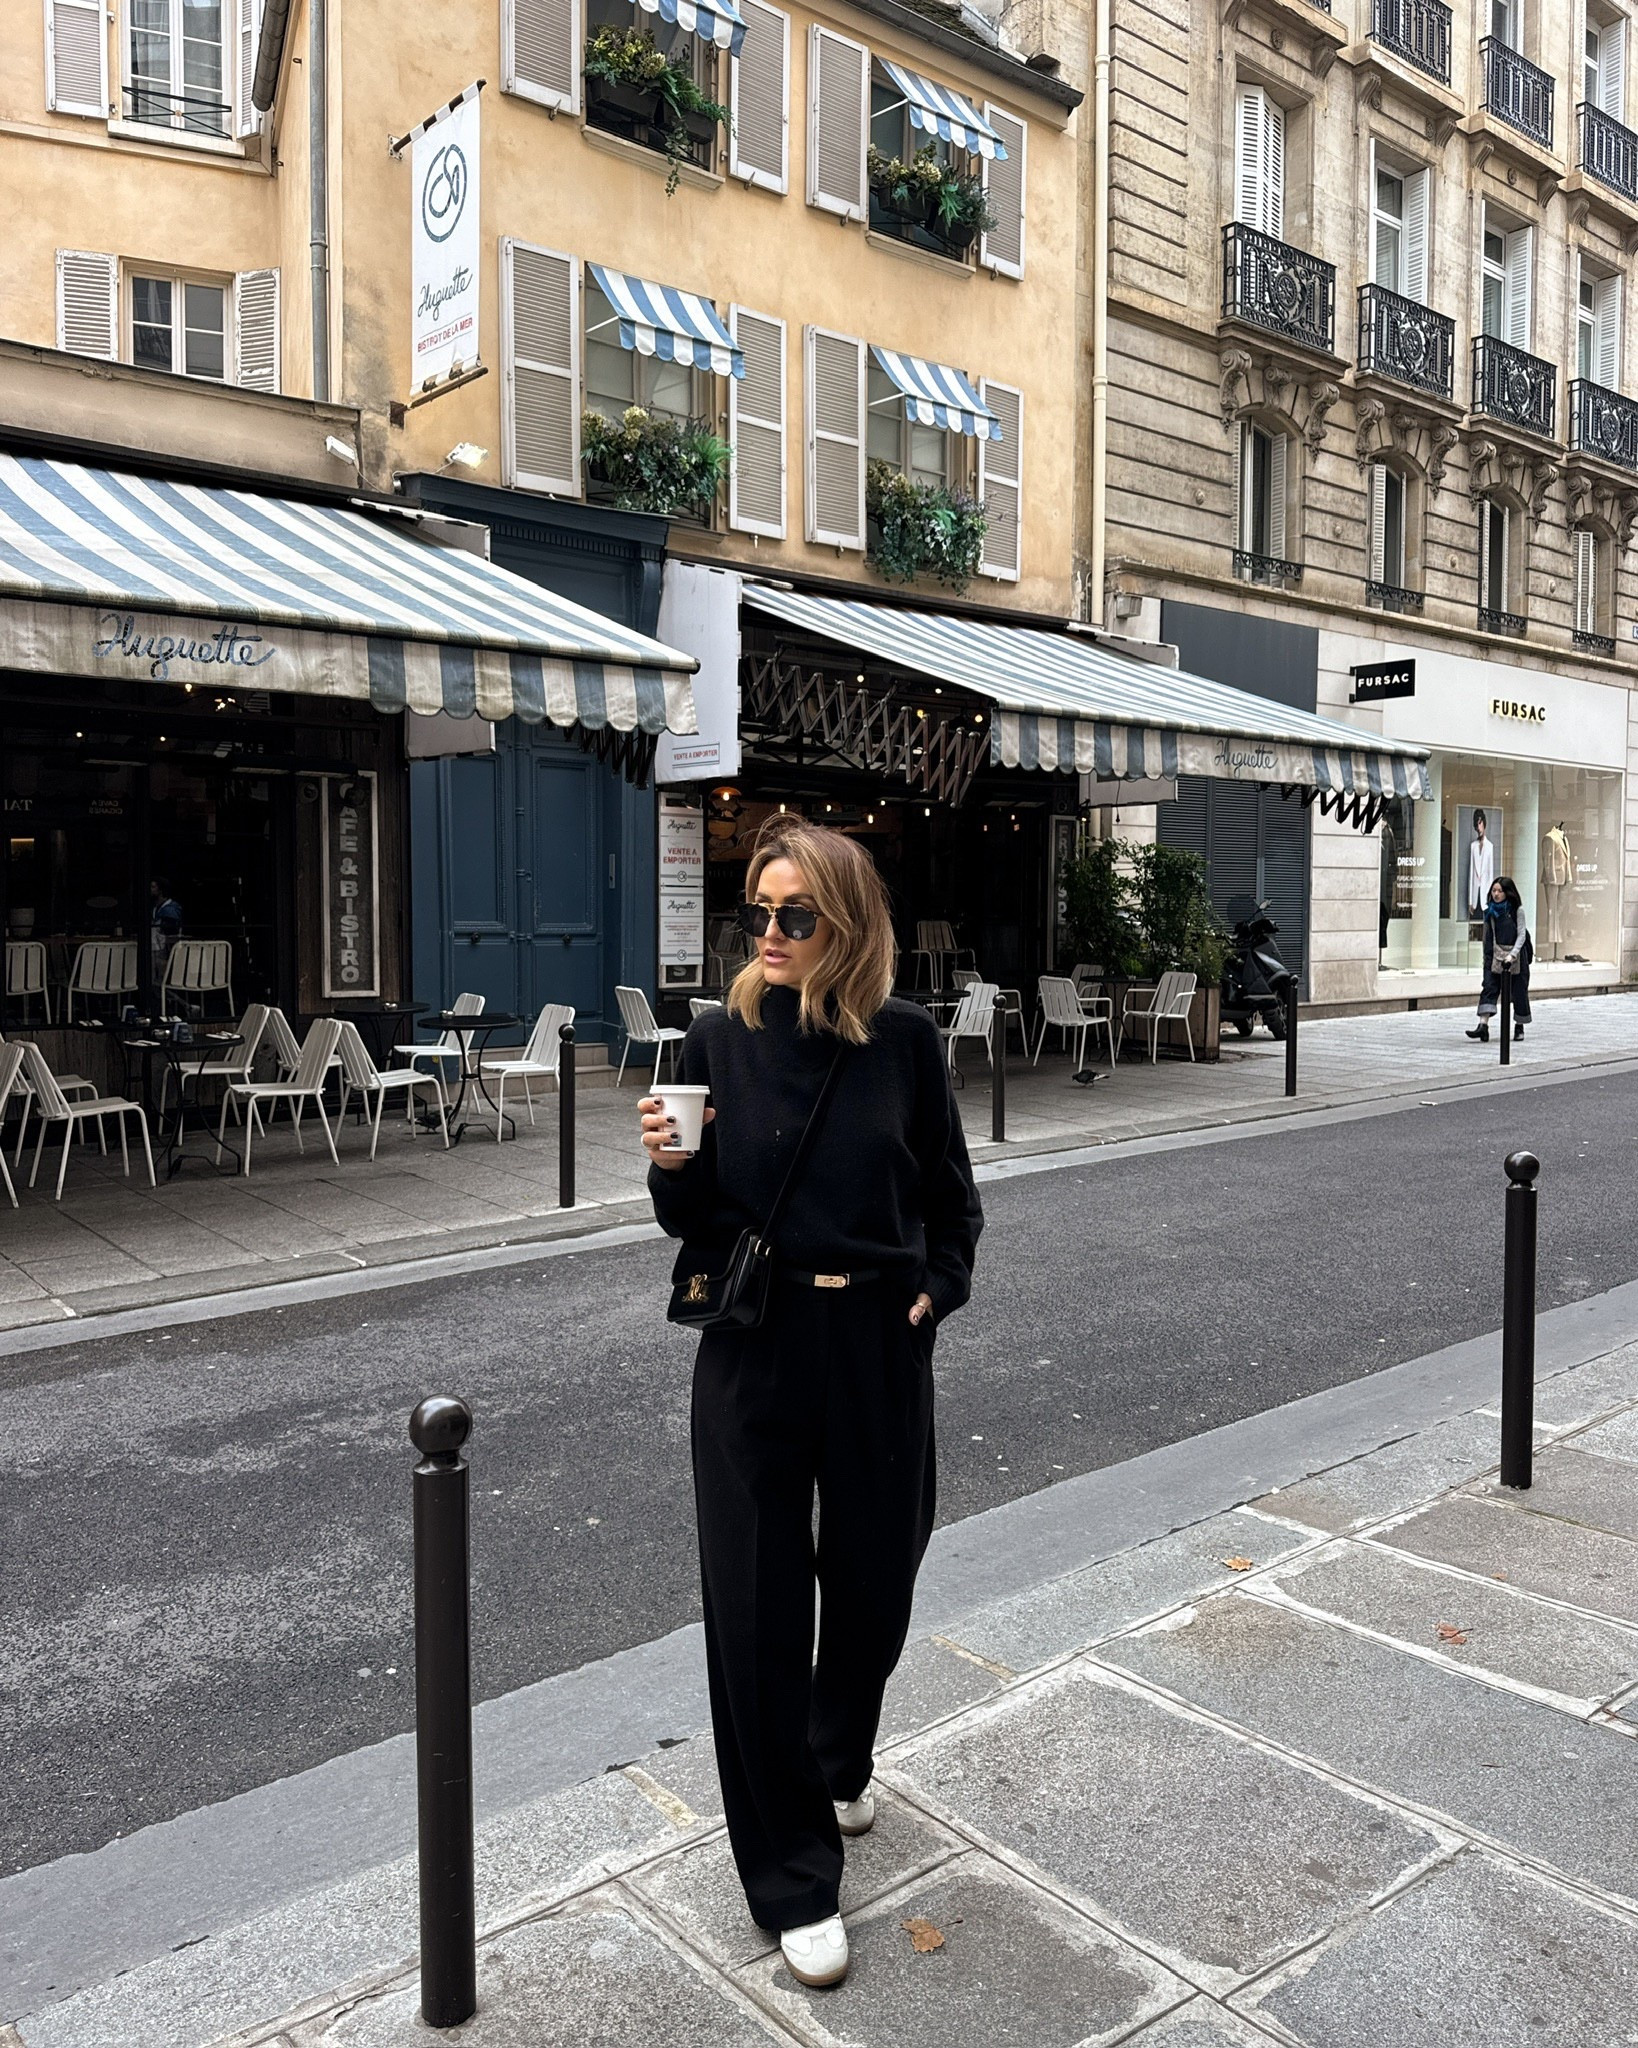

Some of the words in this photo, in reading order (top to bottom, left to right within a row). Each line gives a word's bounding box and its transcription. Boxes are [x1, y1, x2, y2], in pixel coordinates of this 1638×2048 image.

[417, 264, 473, 321] Huguette
[417, 332, 442, 353] BISTROT
[443, 327, 451, 340] DE
[451, 323, 459, 336] LA
[460, 317, 473, 331] MER
[92, 613, 276, 681] Huguette
[1357, 673, 1410, 688] FURSAC
[1492, 699, 1546, 721] FURSAC
[674, 752, 688, 760] VENTE
[692, 749, 718, 758] EMPORTER
[1214, 738, 1279, 779] Huguette
[667, 819, 697, 833] Huguette
[667, 847, 690, 856] VENTE
[340, 857, 358, 875] &
[663, 856, 701, 865] EMPORTER
[1397, 856, 1416, 867] DRESS
[1417, 856, 1425, 867] UP
[667, 900, 697, 914] Huguette
[340, 880, 359, 983] BISTRO
